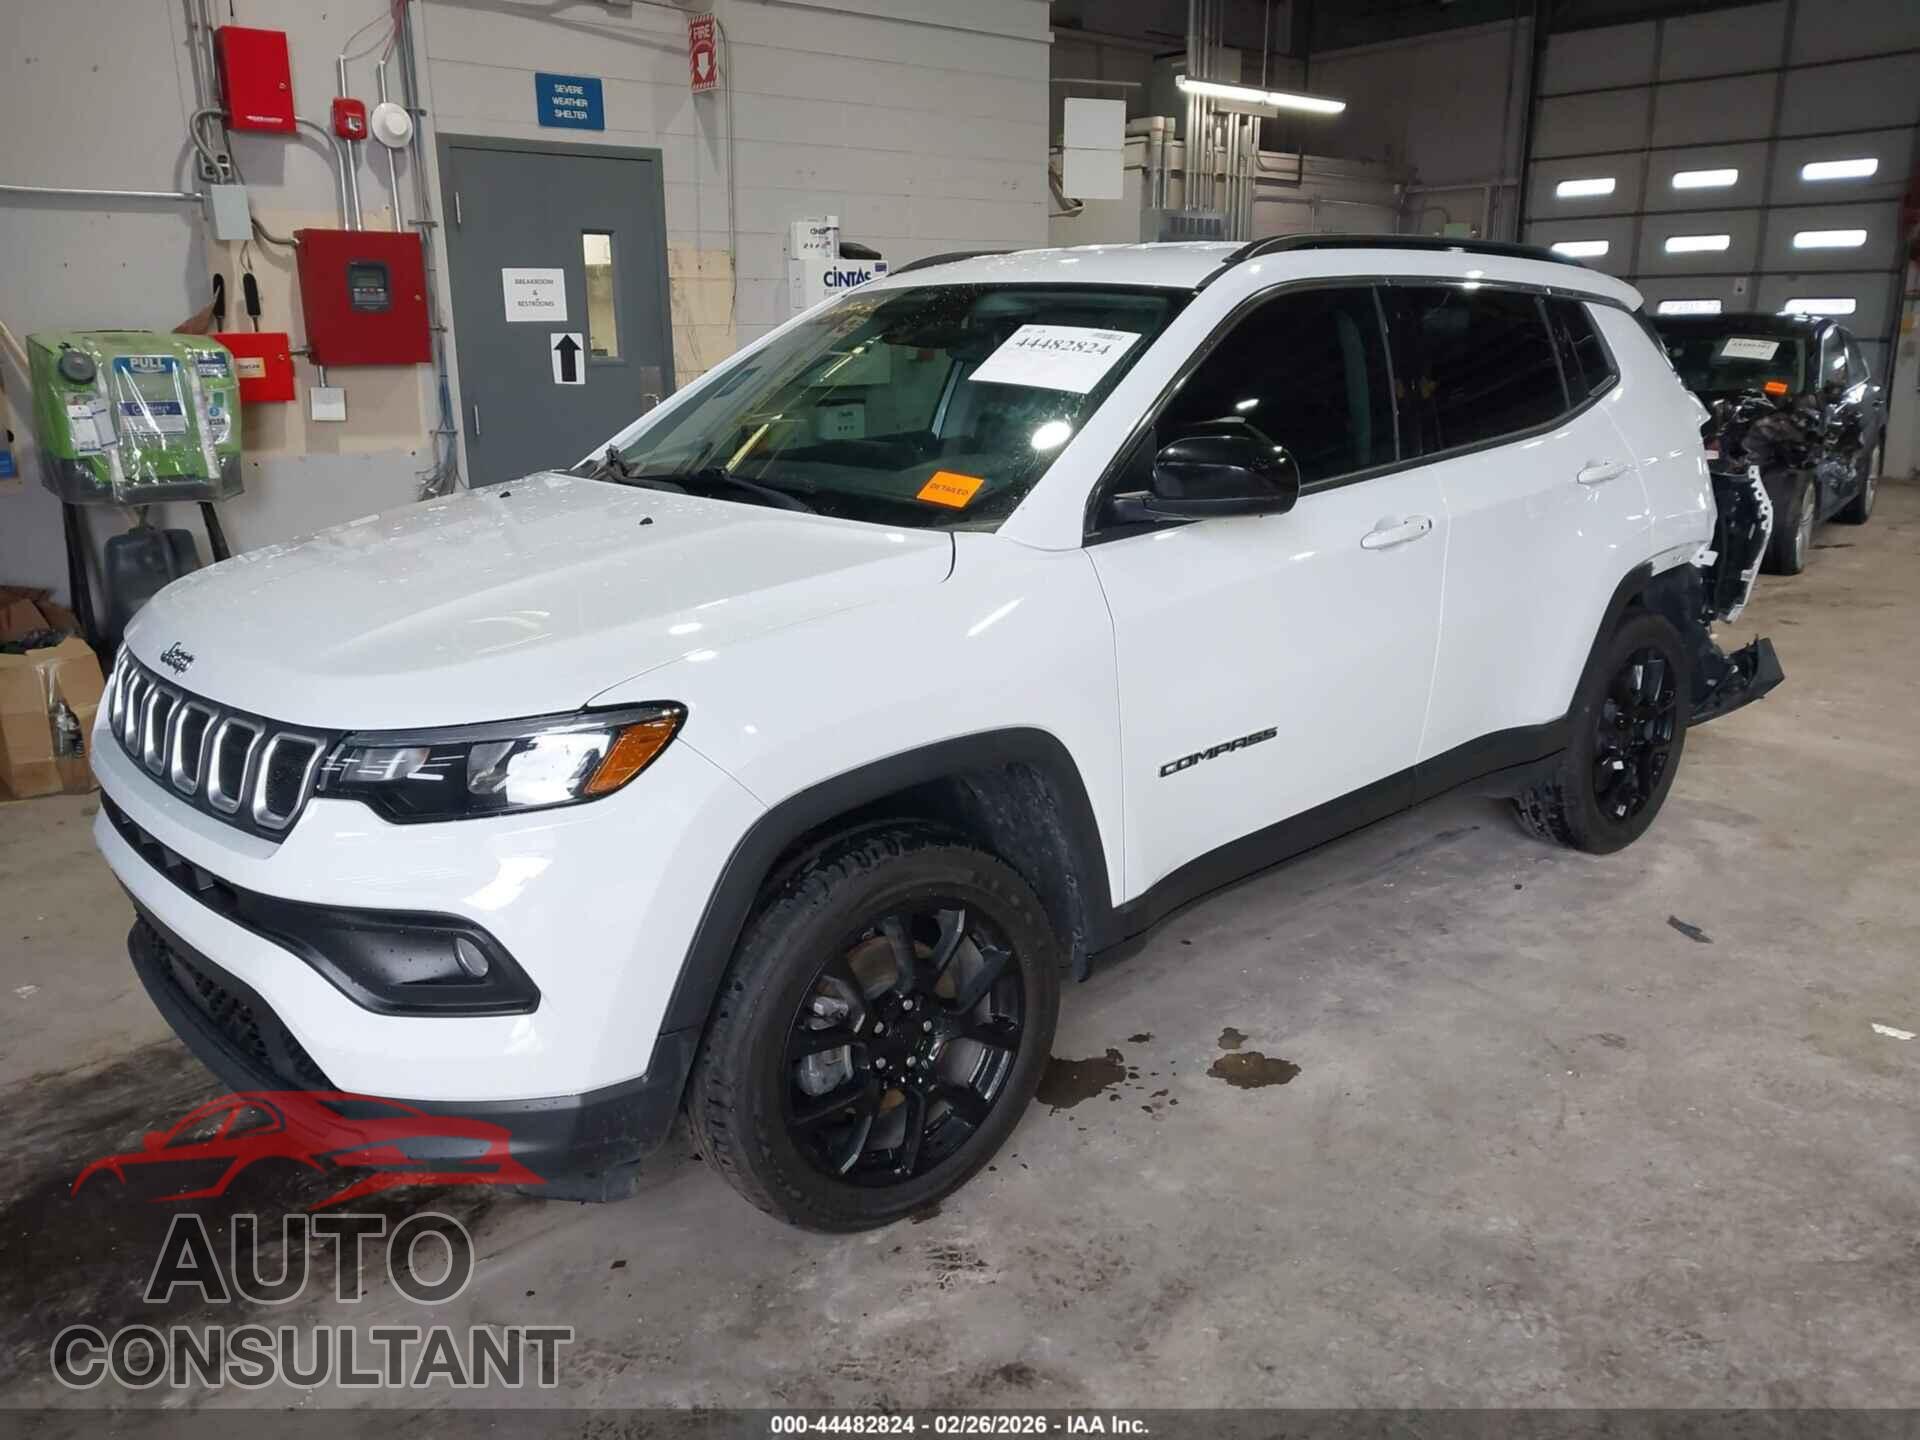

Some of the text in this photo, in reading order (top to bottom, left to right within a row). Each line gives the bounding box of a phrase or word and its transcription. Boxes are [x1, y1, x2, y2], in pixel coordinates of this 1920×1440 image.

[694, 23, 711, 40] FIRE
[554, 84, 584, 95] SEVERE
[552, 96, 588, 107] WEATHER
[554, 109, 588, 120] SHELTER
[1015, 336, 1112, 356] 44482824
[130, 356, 166, 369] PULL
[160, 641, 194, 675] Jeep
[1160, 726, 1278, 778] COMPASS
